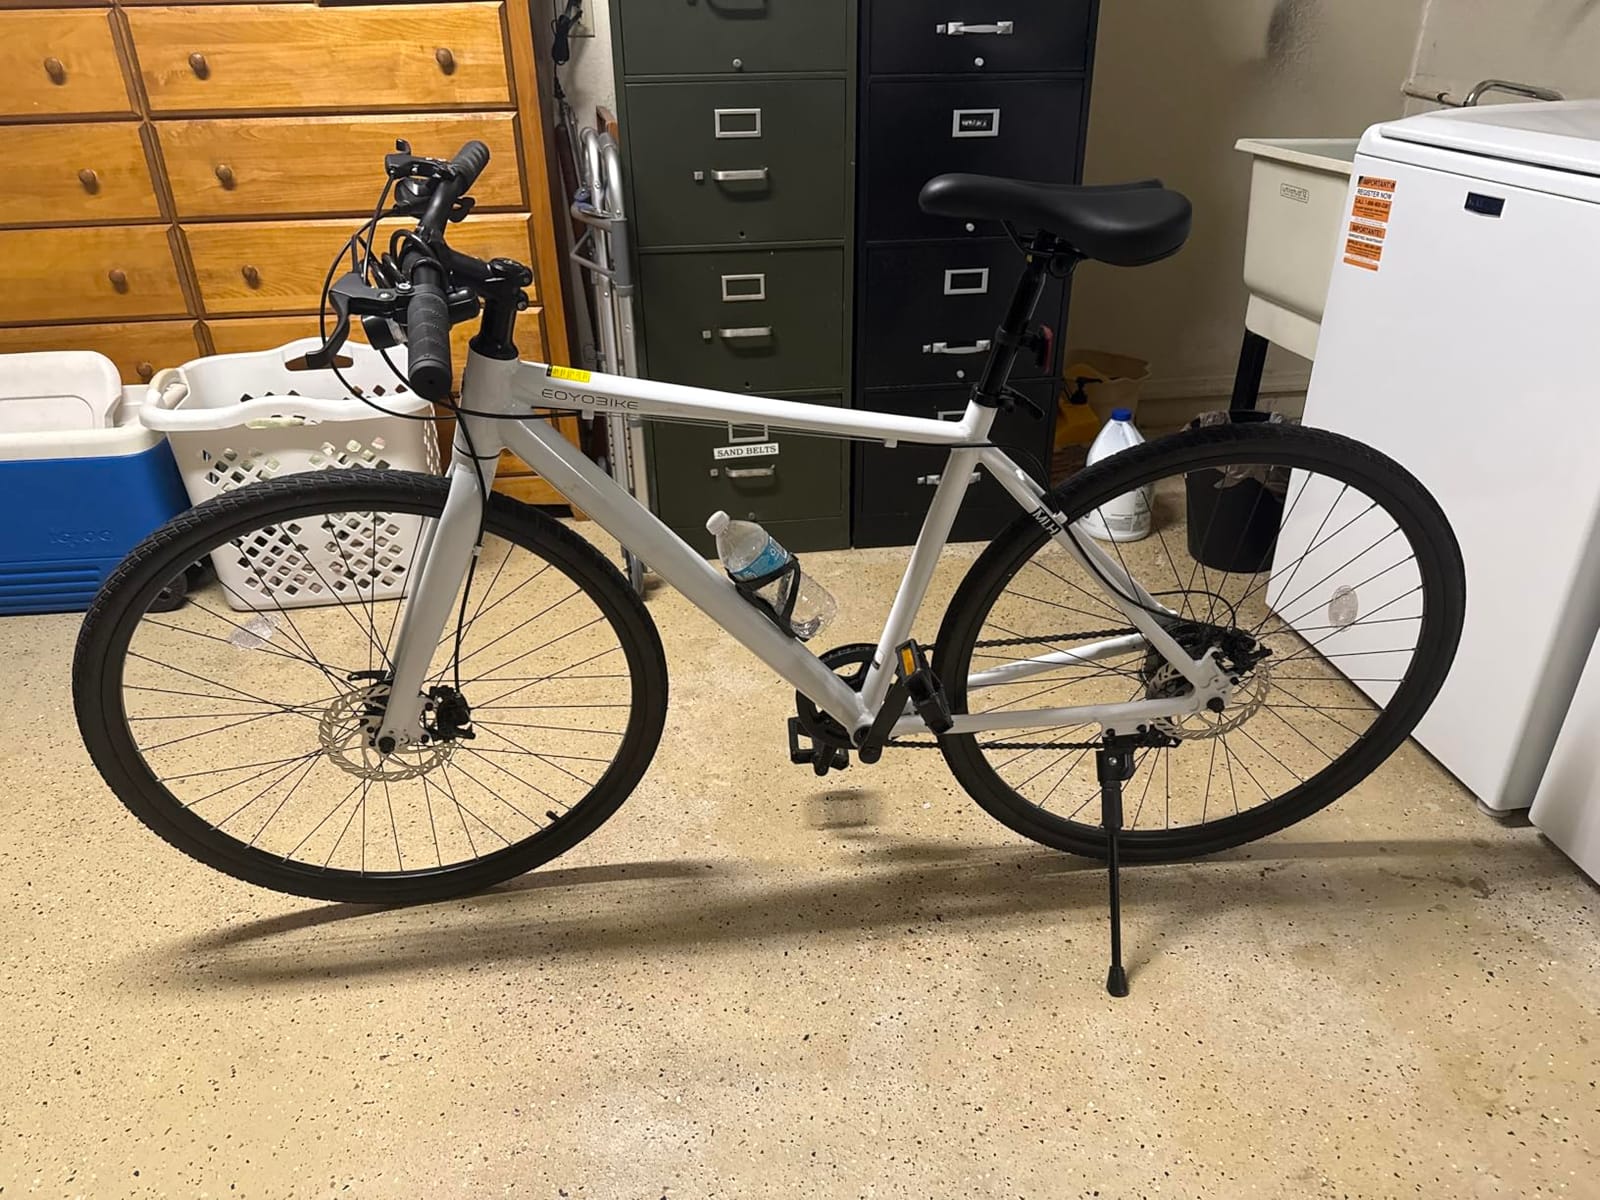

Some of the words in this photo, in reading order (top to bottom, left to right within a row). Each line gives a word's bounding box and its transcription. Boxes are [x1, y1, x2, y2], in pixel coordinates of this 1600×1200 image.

[1358, 188, 1379, 197] REGISTER
[1380, 191, 1392, 200] NOW
[541, 388, 639, 409] EOYOBIKE
[717, 448, 743, 458] SAND
[746, 445, 776, 455] BELTS
